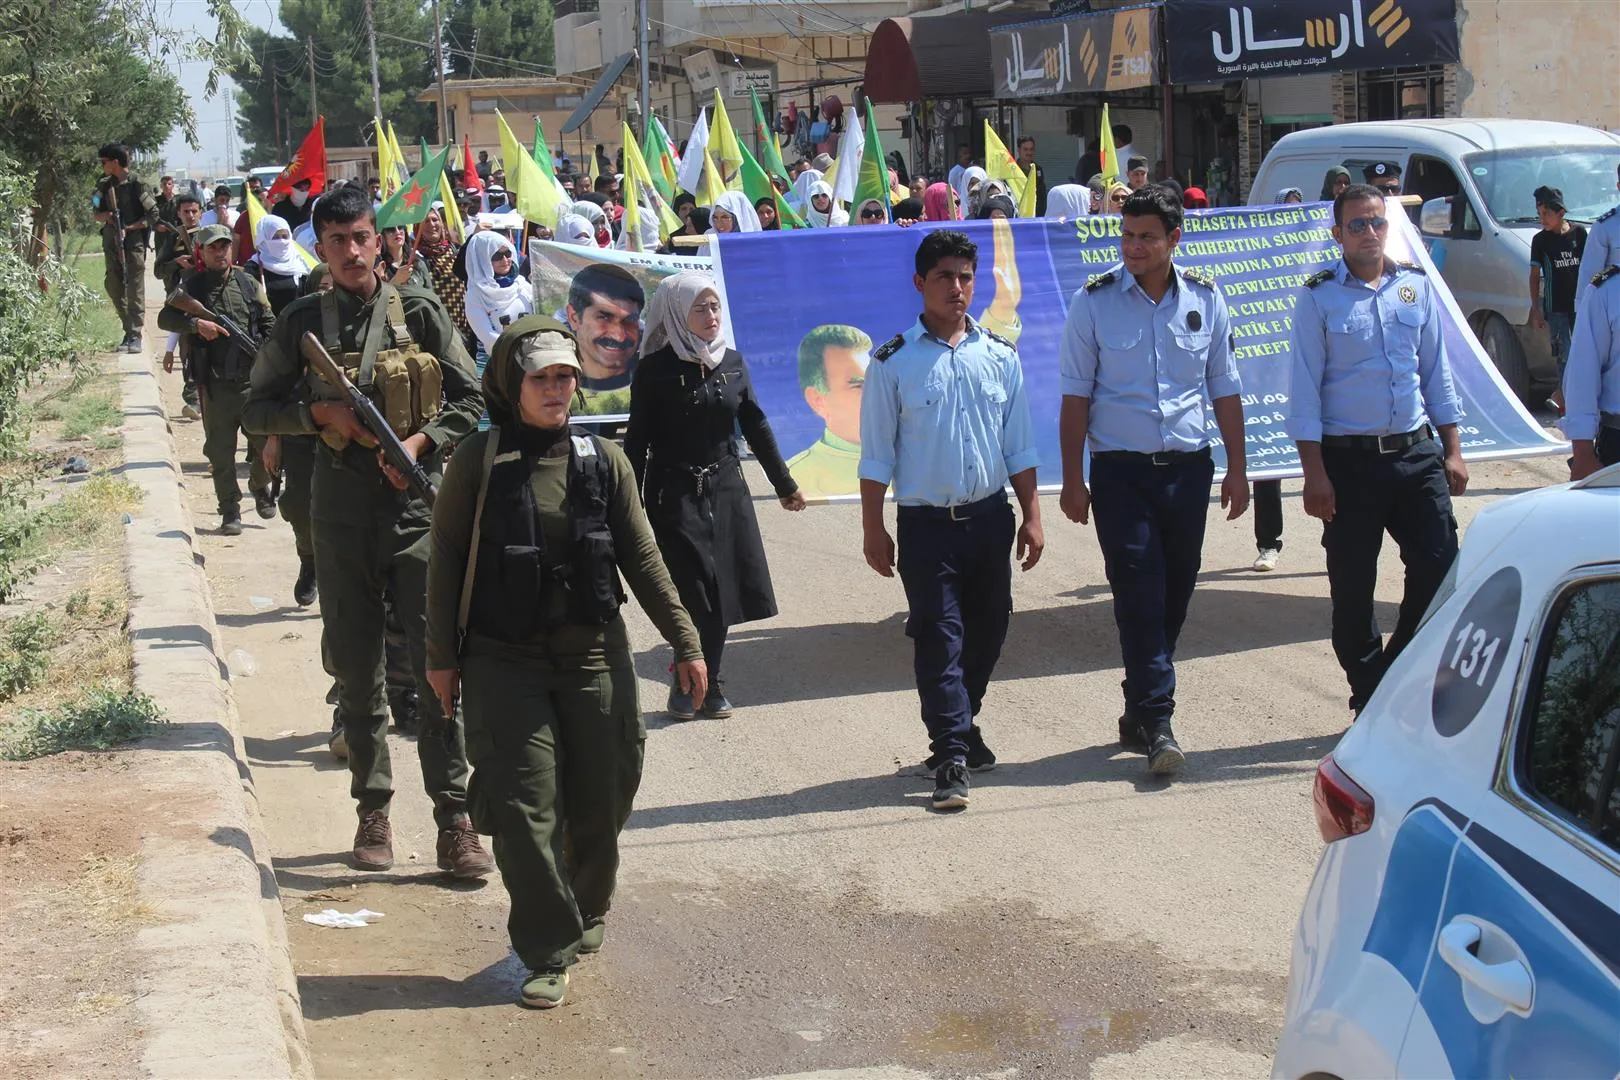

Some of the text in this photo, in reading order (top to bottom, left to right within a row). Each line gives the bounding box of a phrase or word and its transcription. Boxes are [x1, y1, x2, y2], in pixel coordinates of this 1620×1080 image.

[1217, 64, 1242, 74] السورية
[1260, 60, 1283, 69] الداخلية
[1284, 58, 1302, 68] المالية
[1249, 207, 1308, 228] FELSEFÎ
[1081, 245, 1120, 264] NAYÊ
[1186, 237, 1272, 257] GUHERTINA
[1274, 245, 1343, 268] DEWLETÊ
[1240, 298, 1288, 316] CIVAK
[1233, 320, 1271, 339] ATÎK
[1270, 320, 1283, 333] E
[1450, 621, 1502, 687] 131
